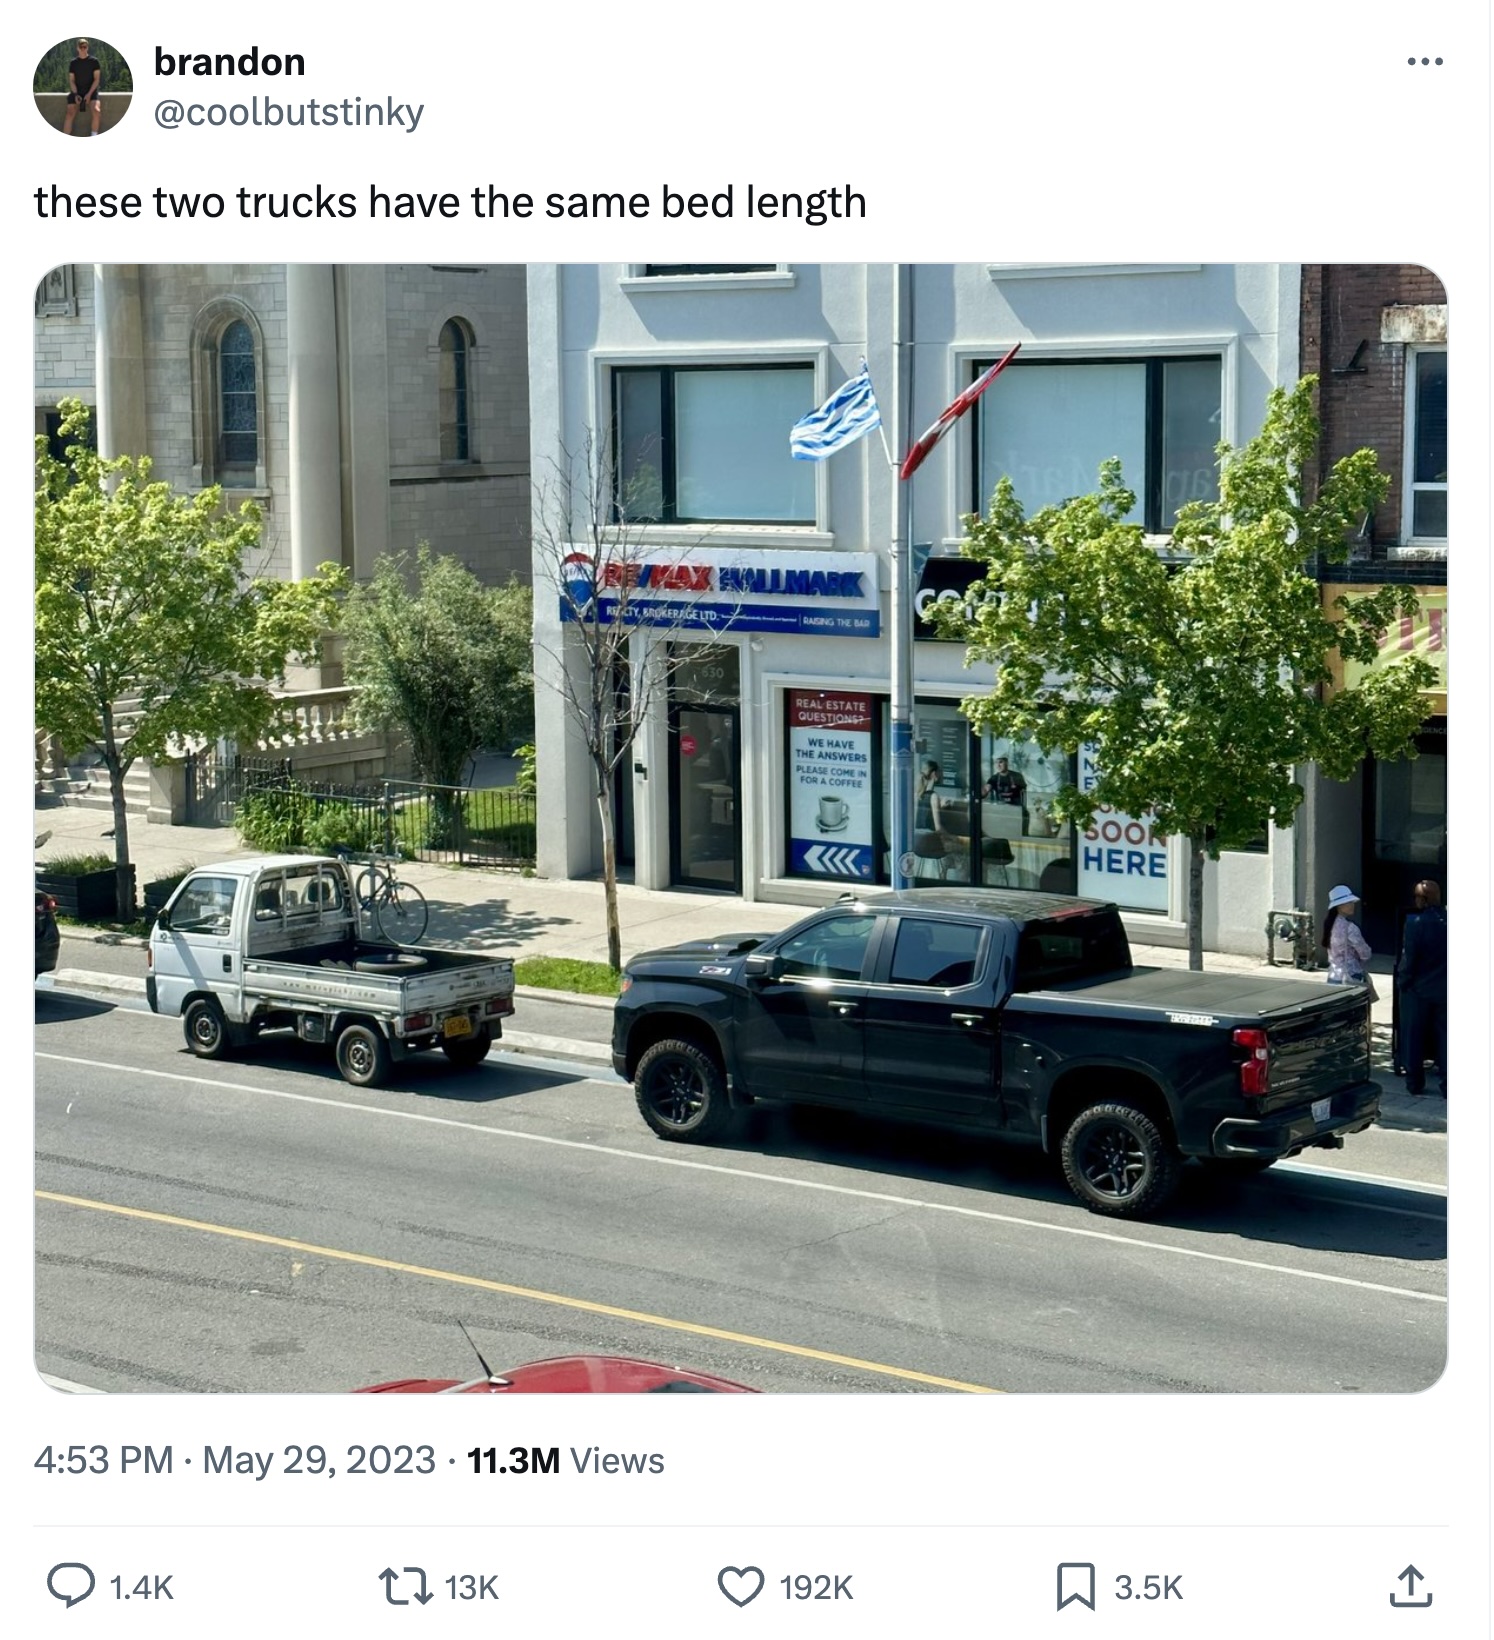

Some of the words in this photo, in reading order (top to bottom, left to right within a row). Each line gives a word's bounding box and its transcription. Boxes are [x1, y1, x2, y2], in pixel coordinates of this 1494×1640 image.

[604, 562, 714, 592] RE/MAX
[719, 566, 865, 598] HALLMARK
[803, 616, 835, 627] RAISING
[837, 617, 852, 628] THE
[854, 618, 871, 628] BAR
[702, 666, 724, 679] 630
[796, 698, 822, 709] REAL
[826, 700, 866, 711] ESTATE
[798, 711, 864, 724] QUESTIONS?
[808, 737, 824, 748] WE
[827, 739, 855, 750] HAVE
[796, 749, 815, 759] THE
[817, 751, 867, 763] ANSWERS
[796, 765, 828, 775] PLEASE
[830, 767, 855, 778] COME
[858, 770, 867, 778] IN
[800, 775, 818, 785] FOR
[820, 777, 827, 785] A
[829, 778, 863, 788] COFFEE
[1084, 819, 1167, 848] SOON
[1084, 846, 1167, 878] HERE
